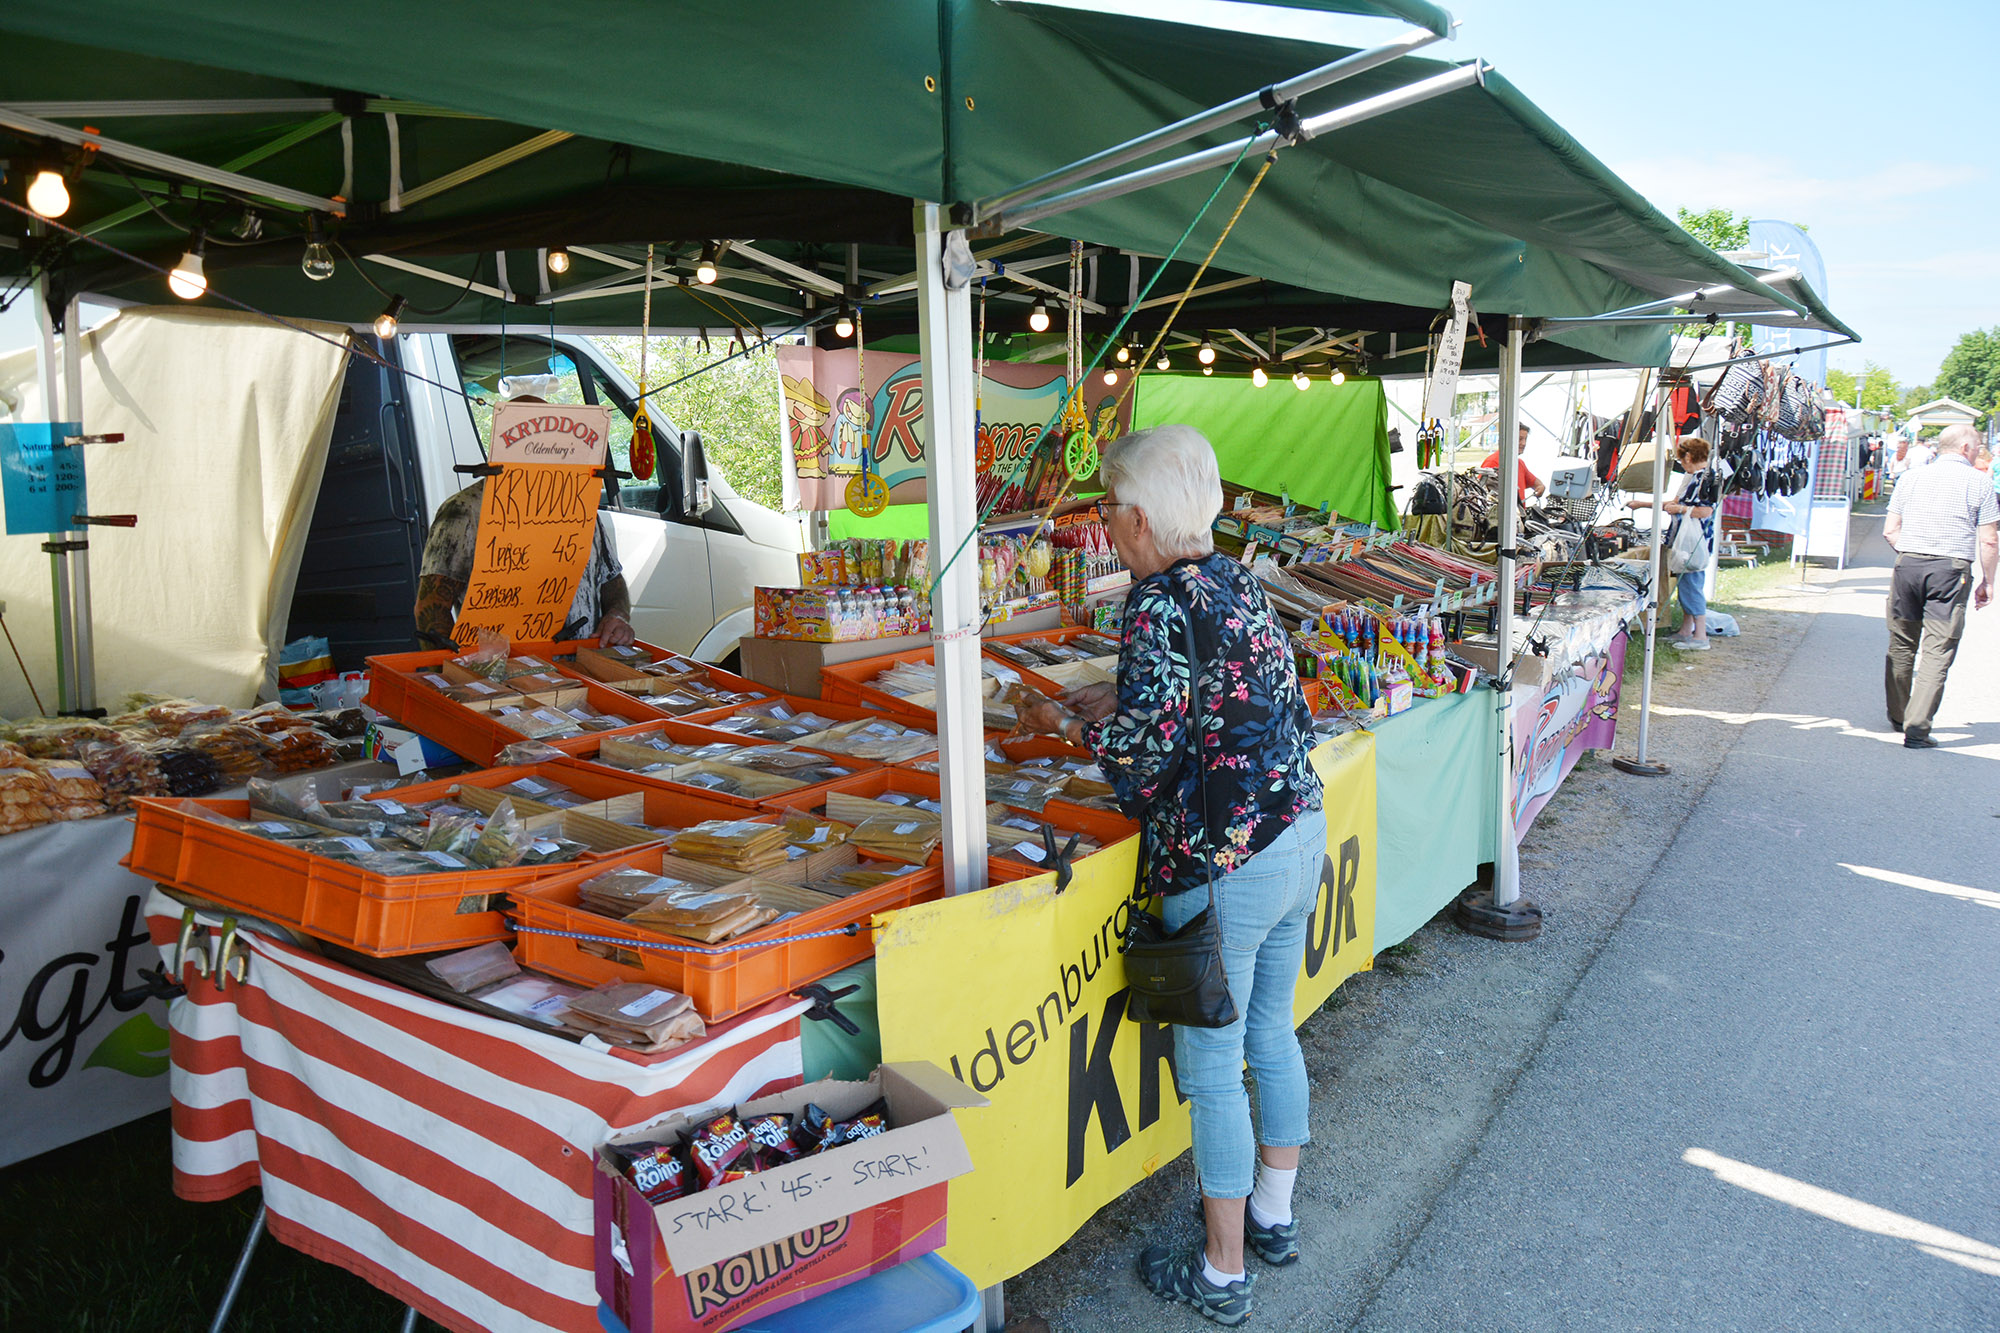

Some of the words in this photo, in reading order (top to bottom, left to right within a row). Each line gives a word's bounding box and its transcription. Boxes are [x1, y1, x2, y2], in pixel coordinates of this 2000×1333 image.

[500, 415, 600, 449] KRYDDOR
[524, 441, 576, 459] Oldenburg's
[490, 467, 592, 531] KRYDDOR
[714, 1119, 731, 1131] Hot
[845, 1119, 867, 1140] aqui
[864, 1113, 880, 1123] Hot
[698, 1121, 748, 1167] Rolitos
[672, 1181, 772, 1235] STARK!
[853, 1146, 933, 1186] STARK!
[703, 1313, 718, 1327] HOT
[719, 1303, 740, 1319] CHILE
[741, 1286, 769, 1307] PEPPER
[776, 1273, 794, 1288] LIME
[794, 1254, 827, 1276] TORTILLA
[827, 1241, 848, 1258] CHIPS
